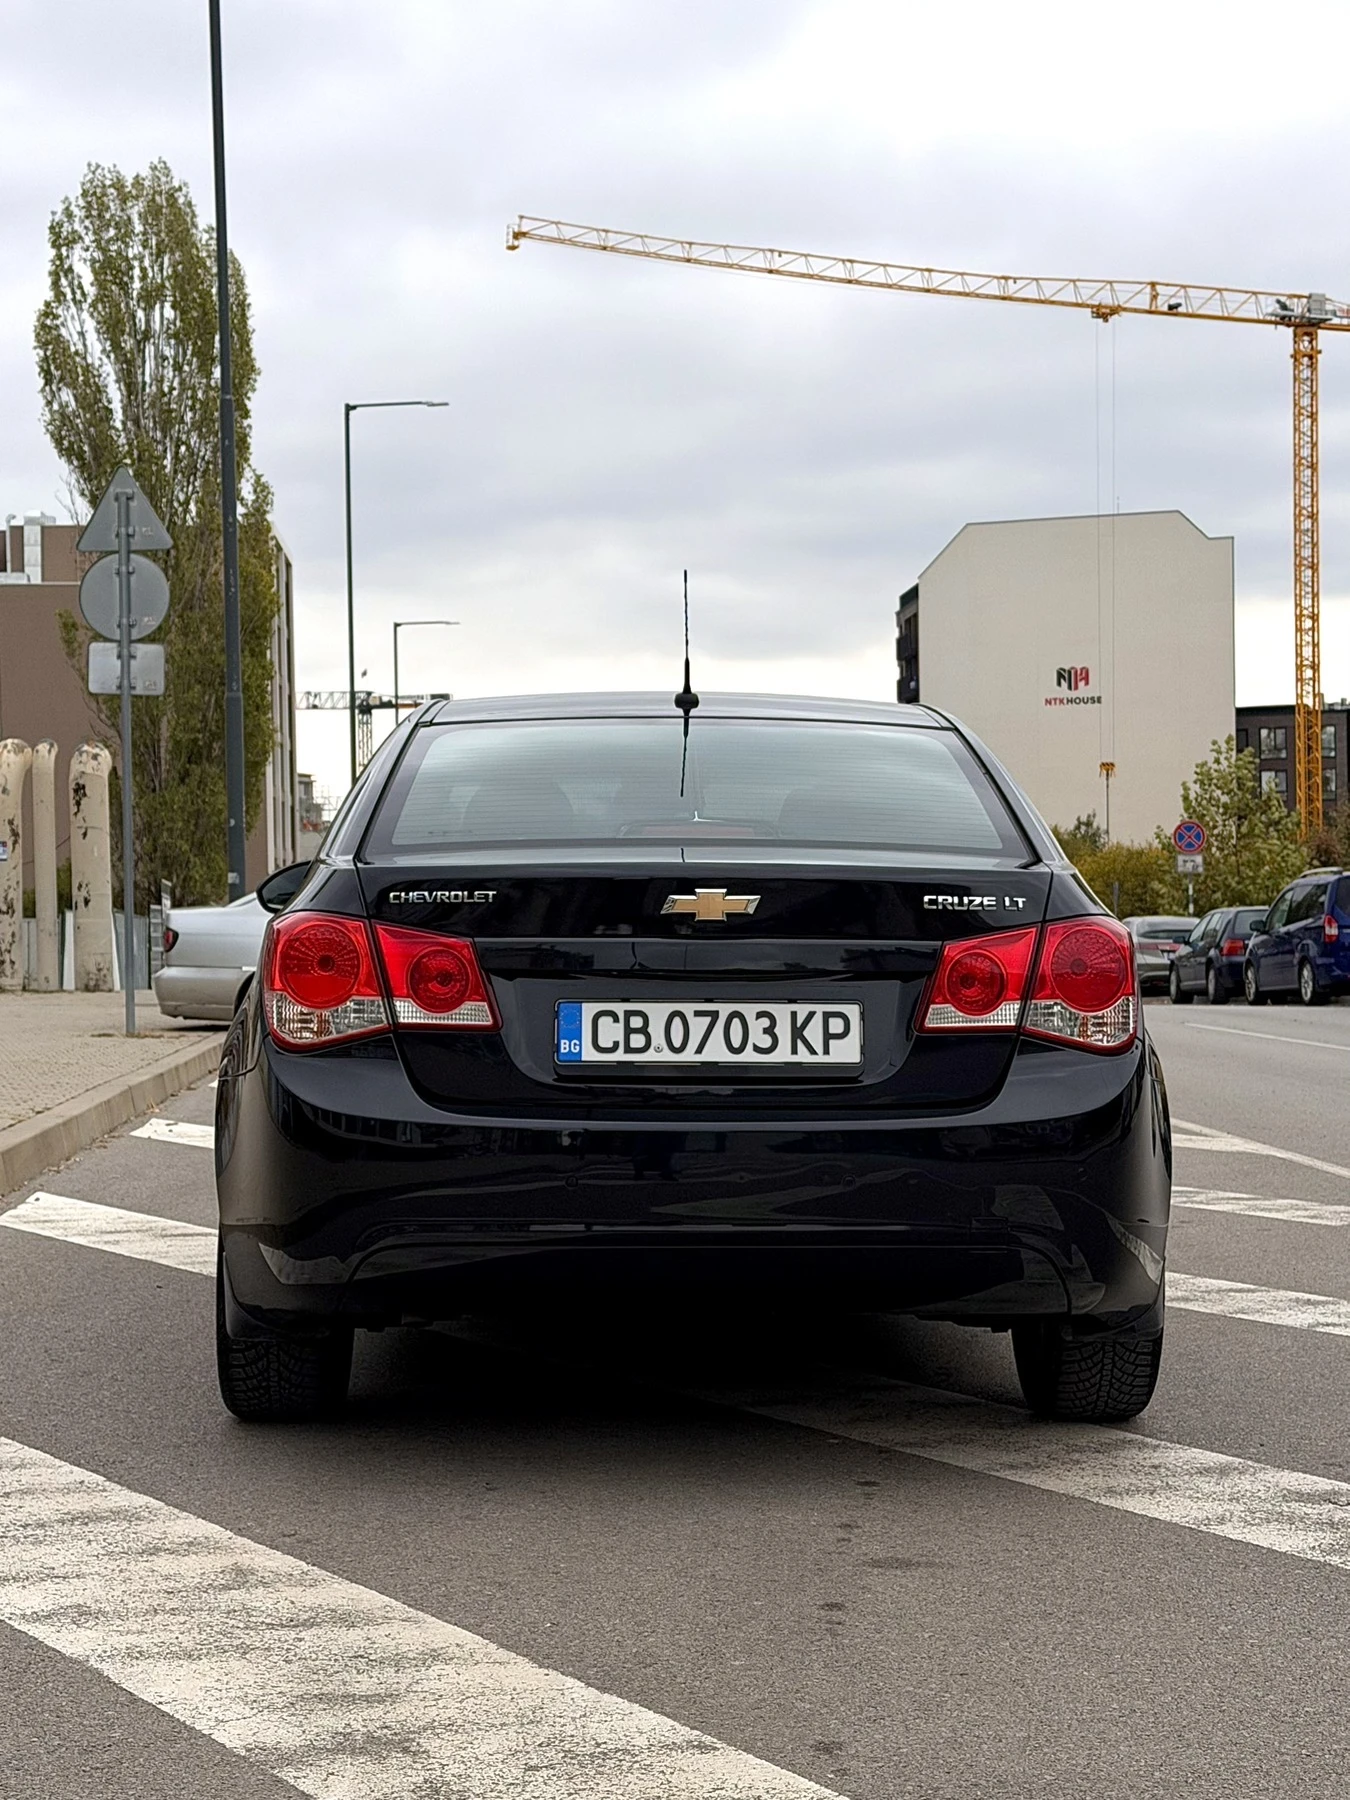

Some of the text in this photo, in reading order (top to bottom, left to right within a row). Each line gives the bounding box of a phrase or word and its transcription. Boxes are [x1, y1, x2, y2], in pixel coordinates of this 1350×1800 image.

[389, 891, 497, 903] CHEVROLET
[923, 895, 1027, 911] CRUZE LT
[560, 1039, 580, 1053] BG
